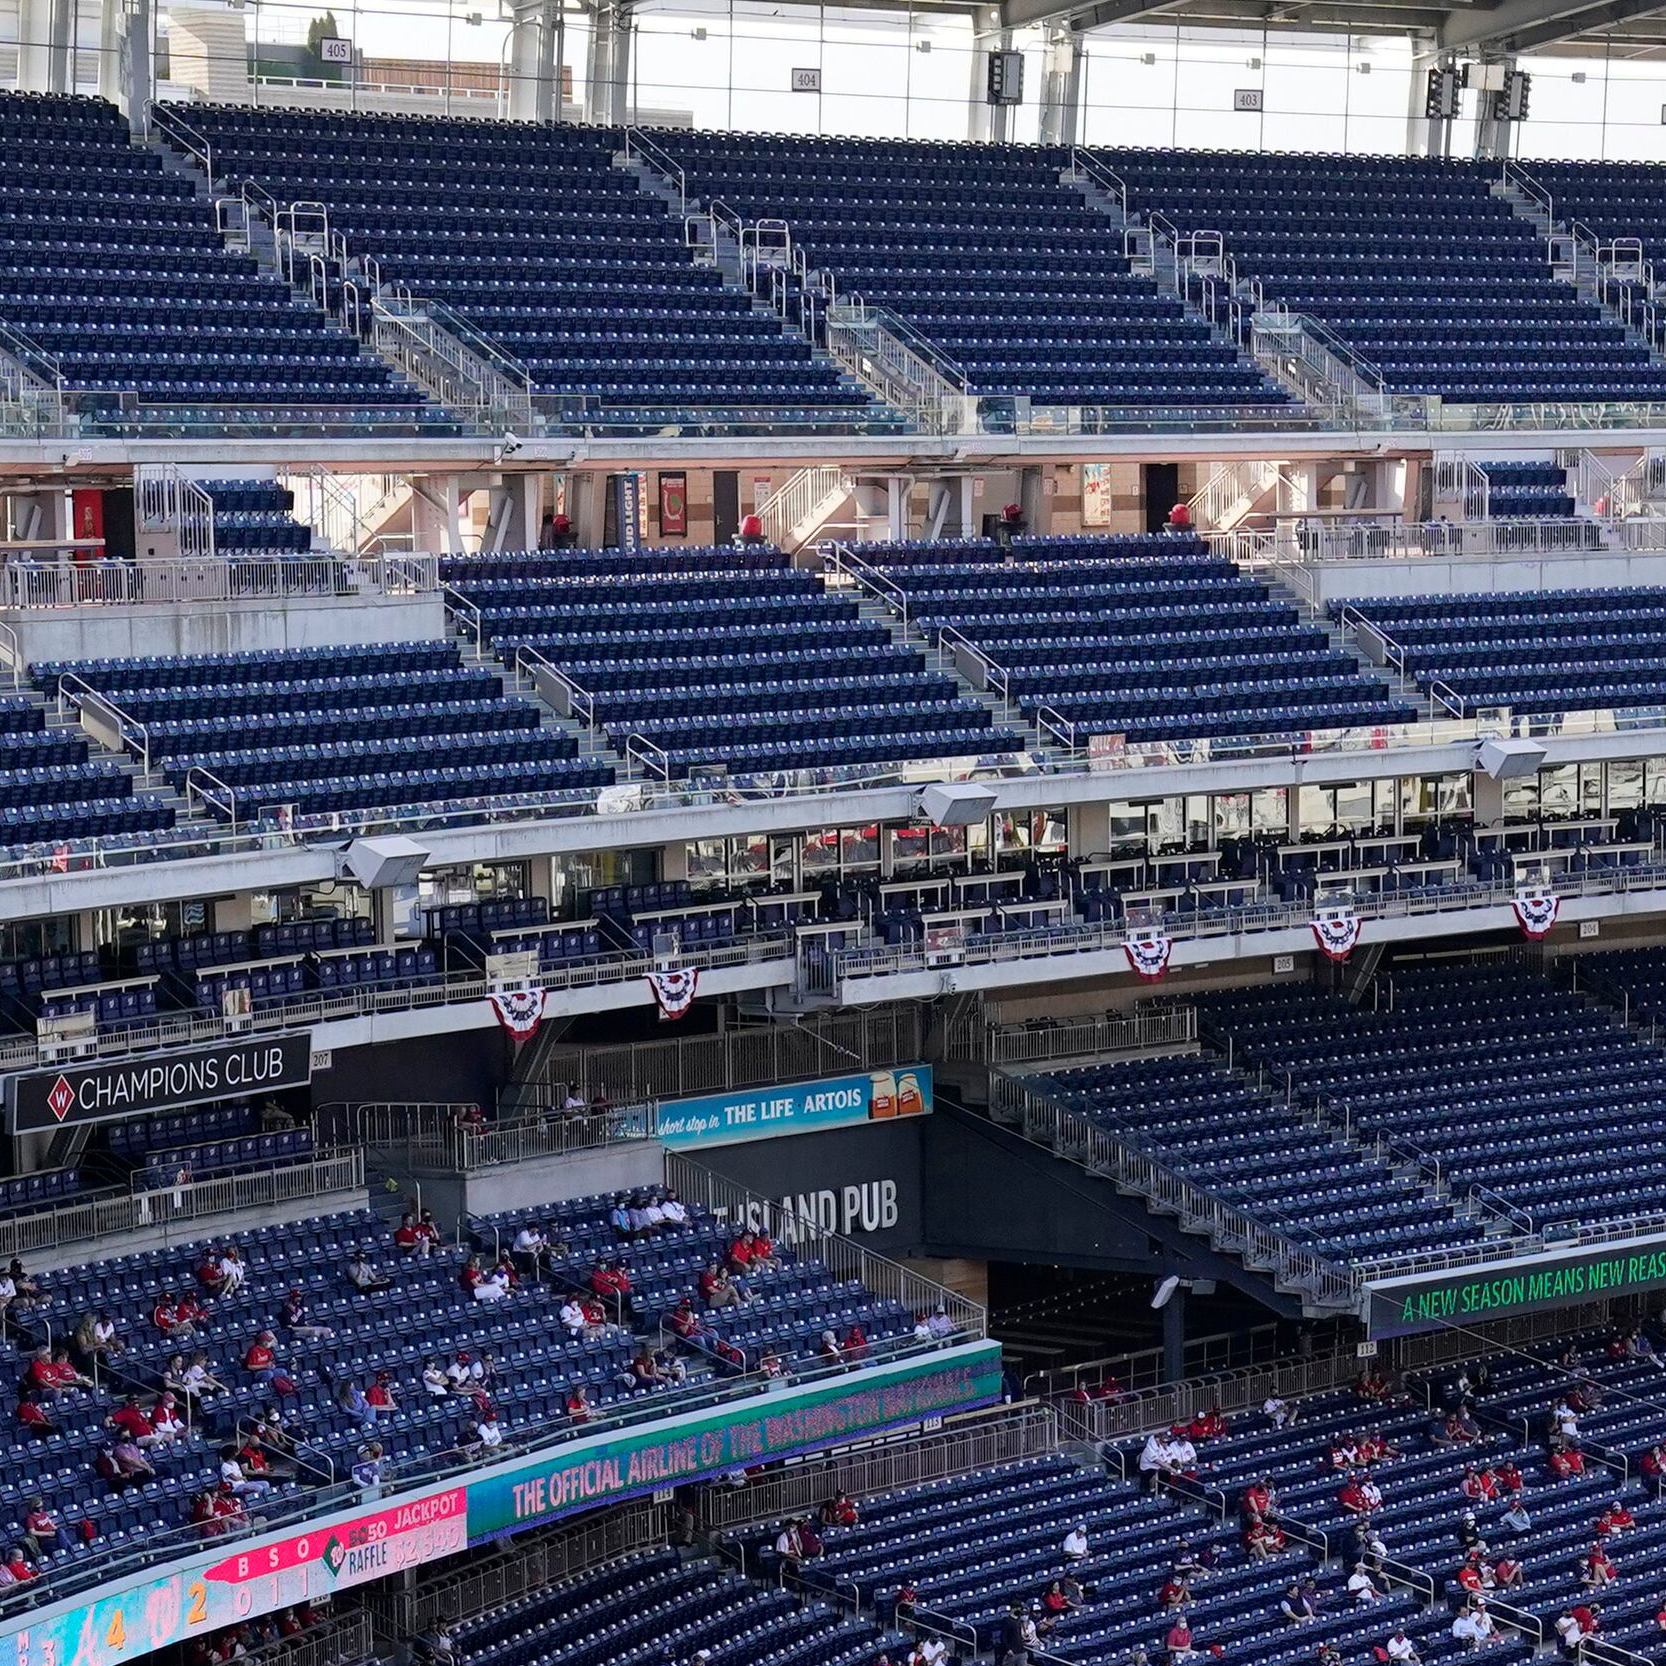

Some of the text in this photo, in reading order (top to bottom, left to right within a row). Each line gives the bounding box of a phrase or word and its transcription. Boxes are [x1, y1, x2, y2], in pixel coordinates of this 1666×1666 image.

[327, 45, 346, 58] 405
[798, 74, 815, 86] 404
[1240, 95, 1257, 106] 403
[623, 480, 634, 520] LIGHT
[78, 1057, 219, 1110] CHAMPIONS
[225, 1047, 283, 1085] CLUB
[313, 1053, 328, 1066] 207
[658, 1116, 684, 1136] short
[686, 1114, 706, 1135] stop
[707, 1113, 720, 1128] in
[724, 1104, 756, 1126] THE
[760, 1099, 794, 1123] LIFE
[804, 1088, 862, 1114] ARTOIS
[844, 1179, 899, 1236] PUB
[1402, 1295, 1414, 1321] A
[1418, 1288, 1457, 1319] NEW
[1461, 1279, 1524, 1313] SEASON
[1529, 1267, 1585, 1301] MEANS
[1588, 1259, 1626, 1291] NEW
[1361, 1341, 1374, 1354] 112
[512, 1477, 546, 1518] THE
[549, 1456, 625, 1507] OFFICIAL
[627, 1436, 698, 1485] AIRLINE
[700, 1429, 726, 1466] OF
[730, 1421, 763, 1457] THE
[394, 1492, 459, 1530] JACKPOT
[238, 1538, 309, 1577] B S O
[349, 1541, 387, 1575] RAFFLE
[188, 1581, 208, 1624] 2
[236, 1568, 309, 1616] 0 1 1
[106, 1609, 125, 1650] 4
